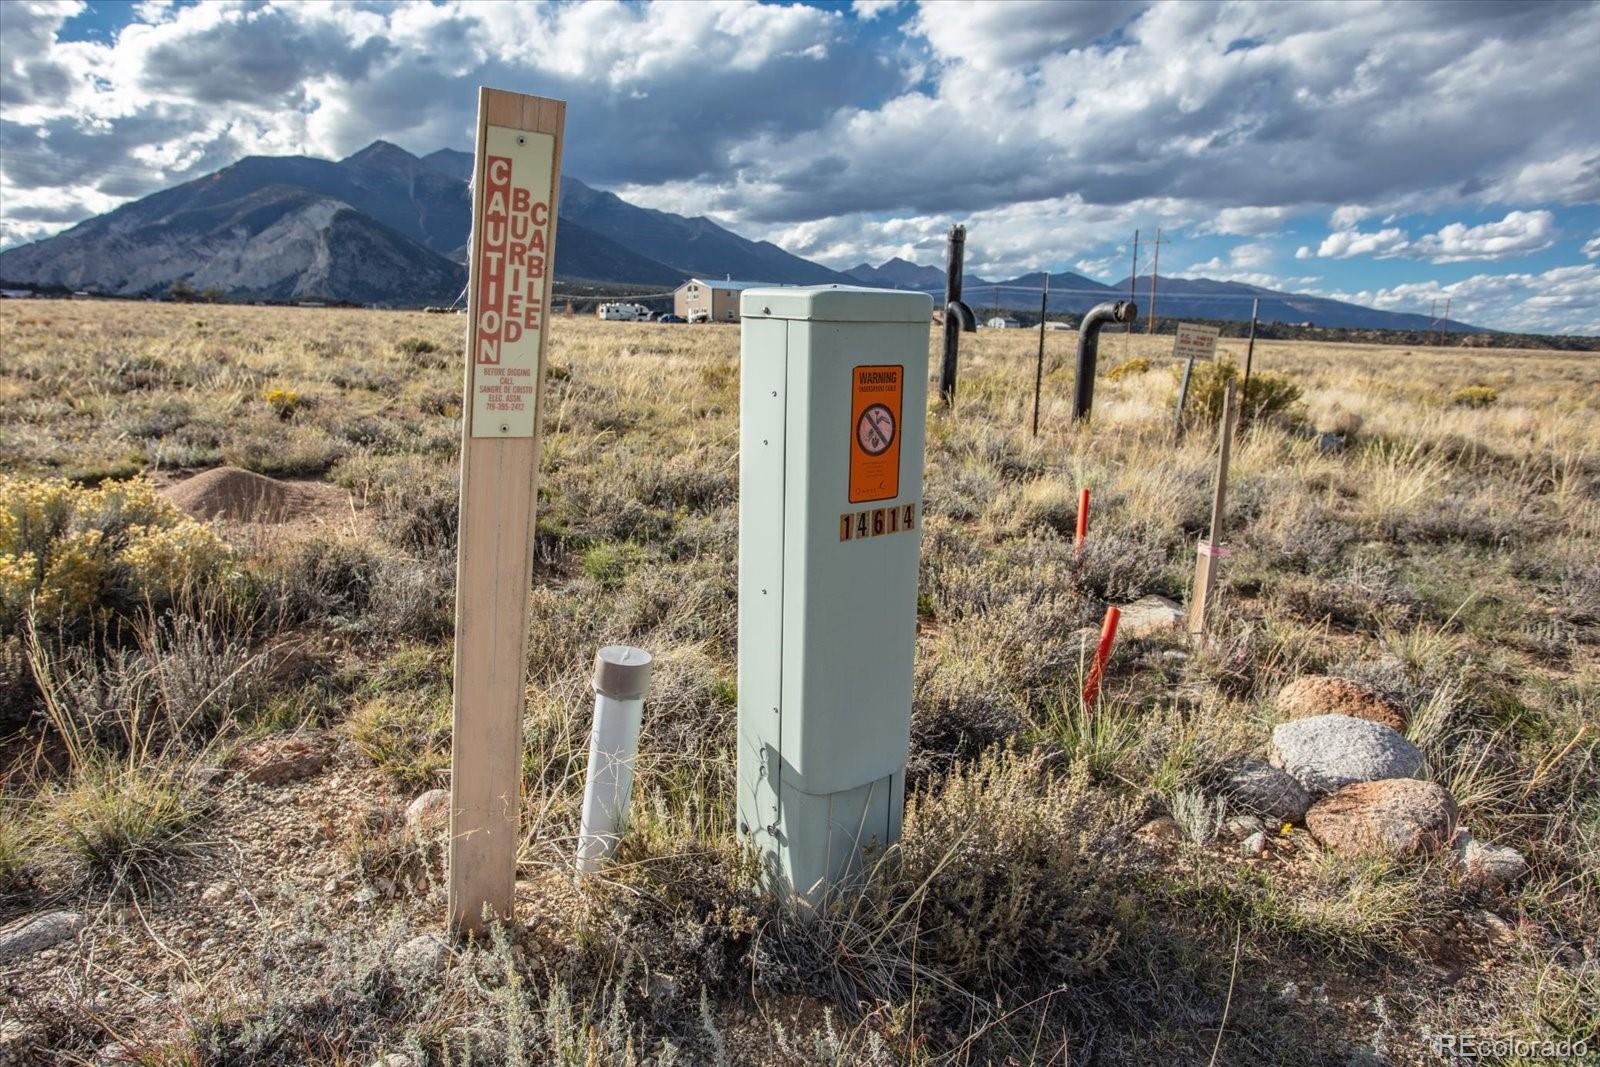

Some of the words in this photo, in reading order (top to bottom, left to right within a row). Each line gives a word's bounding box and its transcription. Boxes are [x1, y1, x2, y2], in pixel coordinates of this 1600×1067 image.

[479, 159, 510, 363] CAUTION
[504, 188, 530, 343] BURIED
[524, 202, 547, 330] CABLE
[484, 368, 505, 376] BEFORE
[507, 368, 531, 376] DIGGING
[500, 377, 513, 385] CALL
[859, 371, 897, 384] WARNING
[480, 385, 502, 393] SANGRE
[503, 385, 511, 393] DE
[512, 386, 533, 394] CRISTO
[841, 503, 912, 542] 14614
